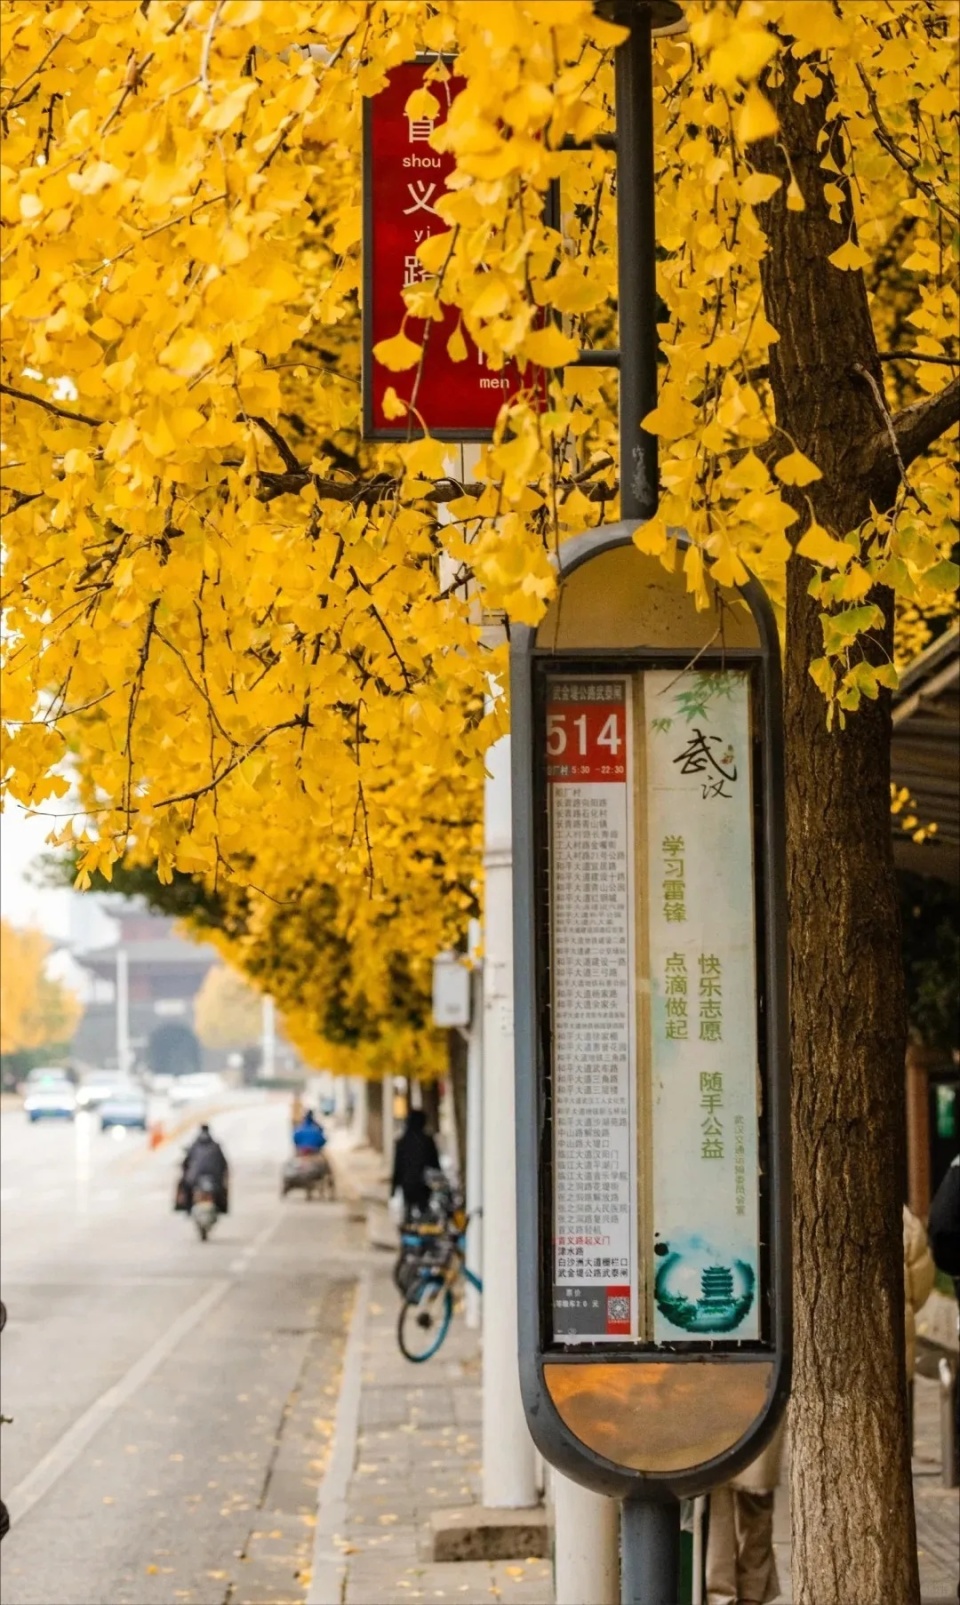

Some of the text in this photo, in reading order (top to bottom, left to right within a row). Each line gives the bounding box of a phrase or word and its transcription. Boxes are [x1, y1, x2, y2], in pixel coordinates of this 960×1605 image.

[402, 153, 441, 168] shou
[403, 180, 438, 215] 义
[479, 376, 510, 389] men
[547, 714, 622, 756] 514
[571, 766, 590, 775] 5:30
[673, 728, 738, 799] 武汉
[662, 835, 687, 924] 学习雷锋
[664, 952, 689, 1040] 点滴做起
[698, 952, 725, 1160] 快乐志愿 随手公益
[558, 1236, 610, 1246] 首义路起义门
[558, 1247, 584, 1256] 津水路
[558, 1258, 628, 1267] 白沙洲大道栅栏口
[558, 1268, 628, 1278] 武金堤公路武泰闸
